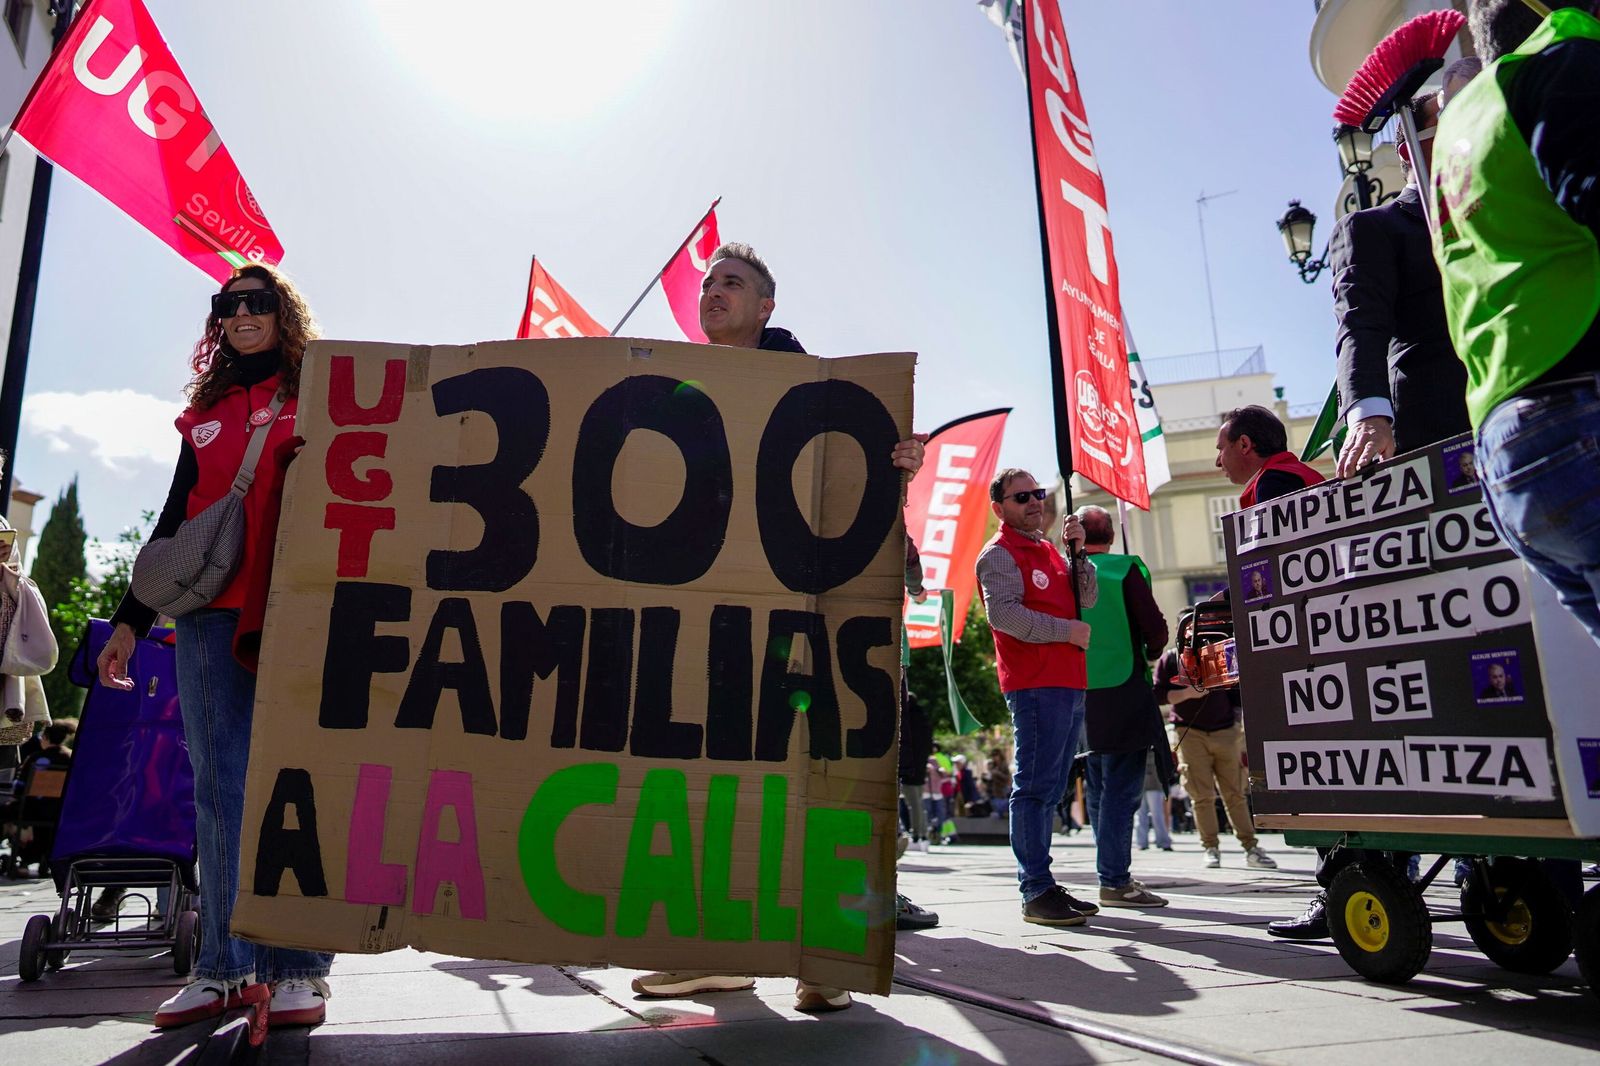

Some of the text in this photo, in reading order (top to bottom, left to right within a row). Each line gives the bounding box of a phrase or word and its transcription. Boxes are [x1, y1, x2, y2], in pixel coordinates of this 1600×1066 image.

[184, 191, 266, 264] Sevilla
[323, 355, 406, 577] UGT
[426, 366, 901, 592] 300
[1238, 466, 1429, 545] LIMPIEZA
[1281, 507, 1500, 588] COLEGIOS
[1250, 610, 1293, 647] LO
[318, 580, 897, 762] FAMILIAS
[1288, 672, 1427, 715] NO SE
[1276, 744, 1537, 788] PRIVATIZA
[253, 761, 873, 954] A LA CALLE
